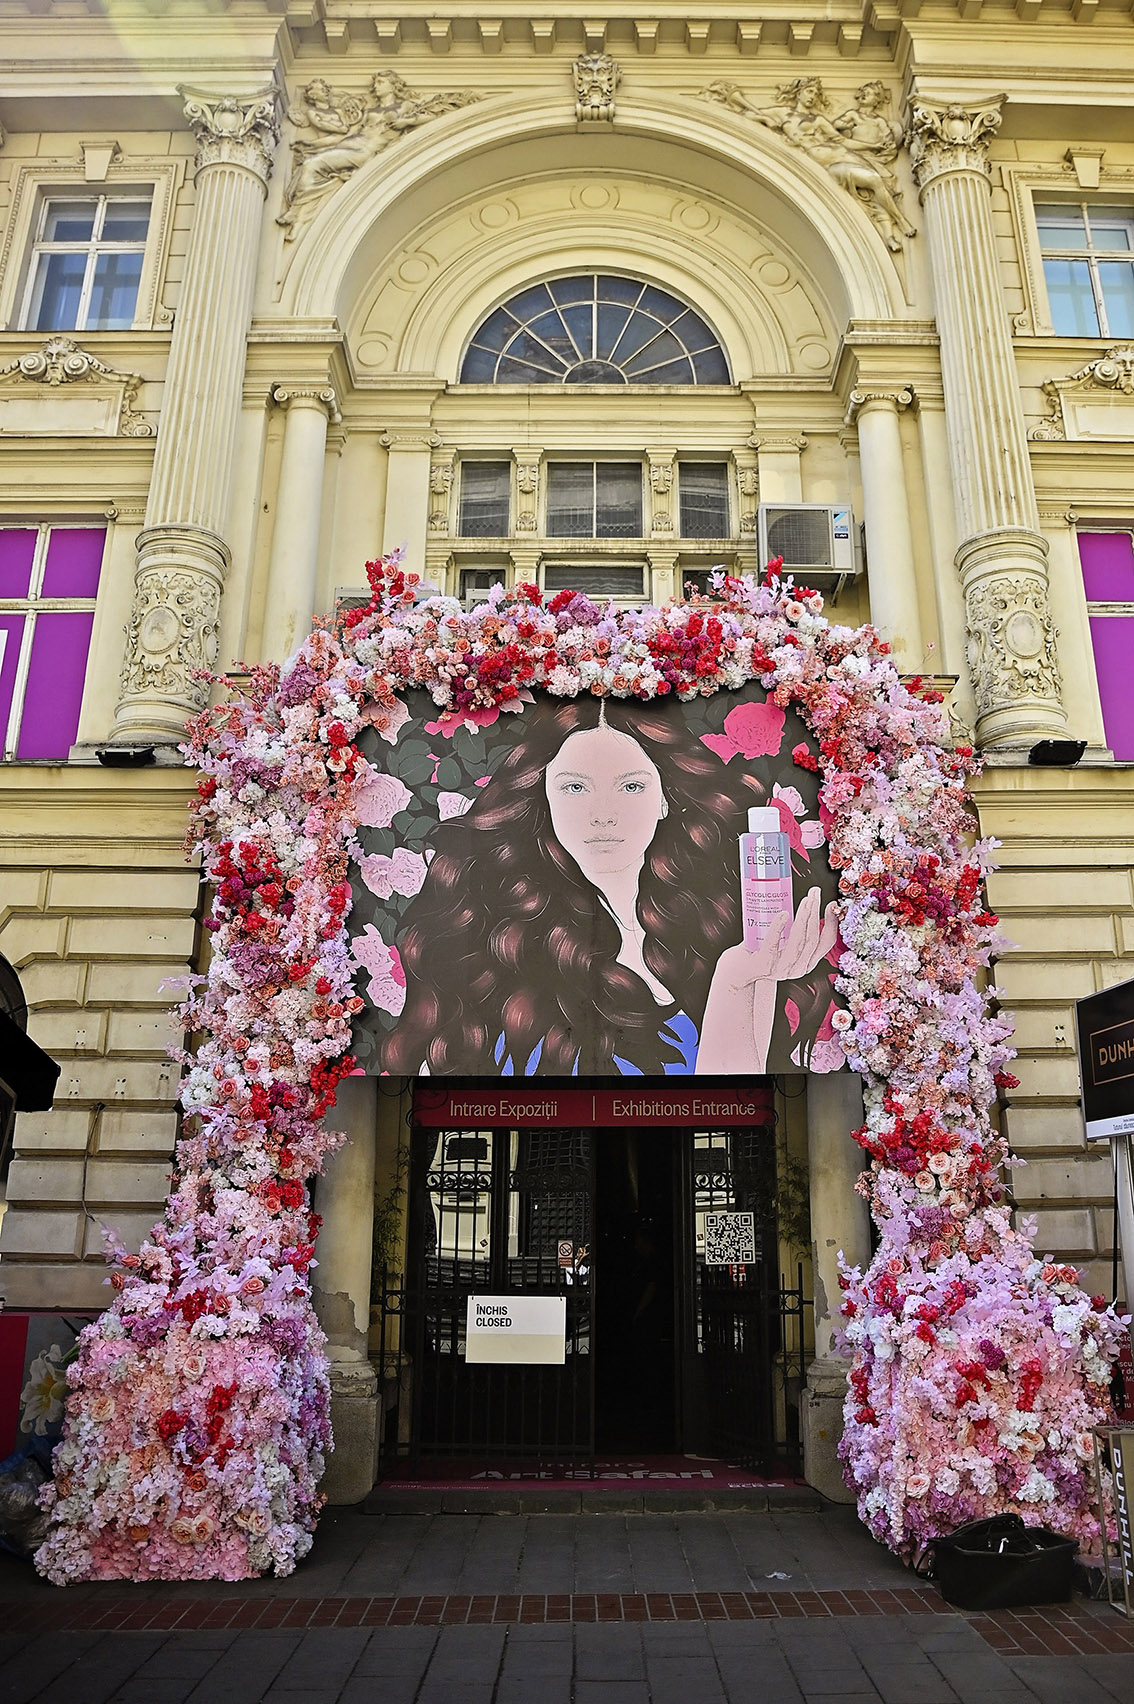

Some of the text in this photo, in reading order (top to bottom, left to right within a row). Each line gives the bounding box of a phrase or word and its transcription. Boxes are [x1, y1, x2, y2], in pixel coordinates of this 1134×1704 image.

[747, 855, 785, 866] ELSEVE
[450, 1100, 558, 1121] Intrare Expoziții
[612, 1099, 756, 1117] Exhibitions Entrance
[475, 1303, 508, 1316] ÎNCHIS
[475, 1317, 513, 1328] CLOSED
[468, 1469, 715, 1480] Art Safari
[1113, 1447, 1134, 1586] DUNHILL
